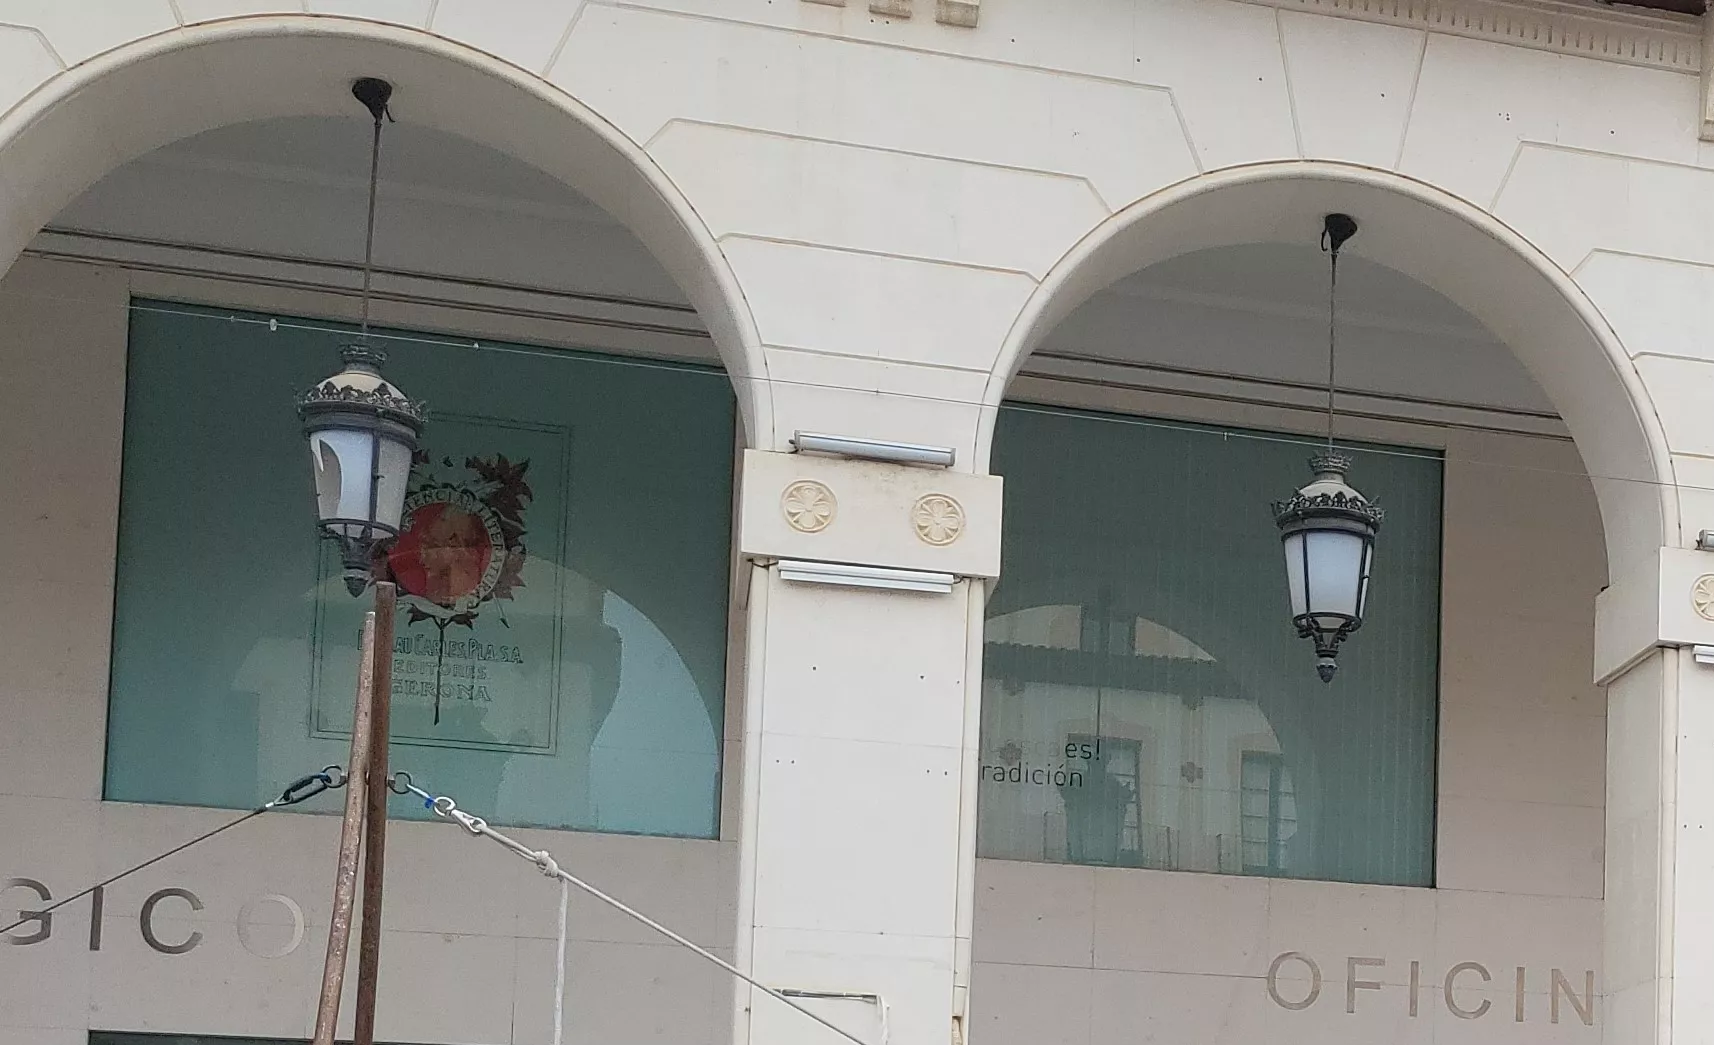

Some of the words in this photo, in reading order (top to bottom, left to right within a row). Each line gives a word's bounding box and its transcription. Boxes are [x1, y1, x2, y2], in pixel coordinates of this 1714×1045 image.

[1064, 738, 1100, 761] es!
[981, 761, 1083, 788] radición
[1267, 951, 1595, 1026] OFICIN
